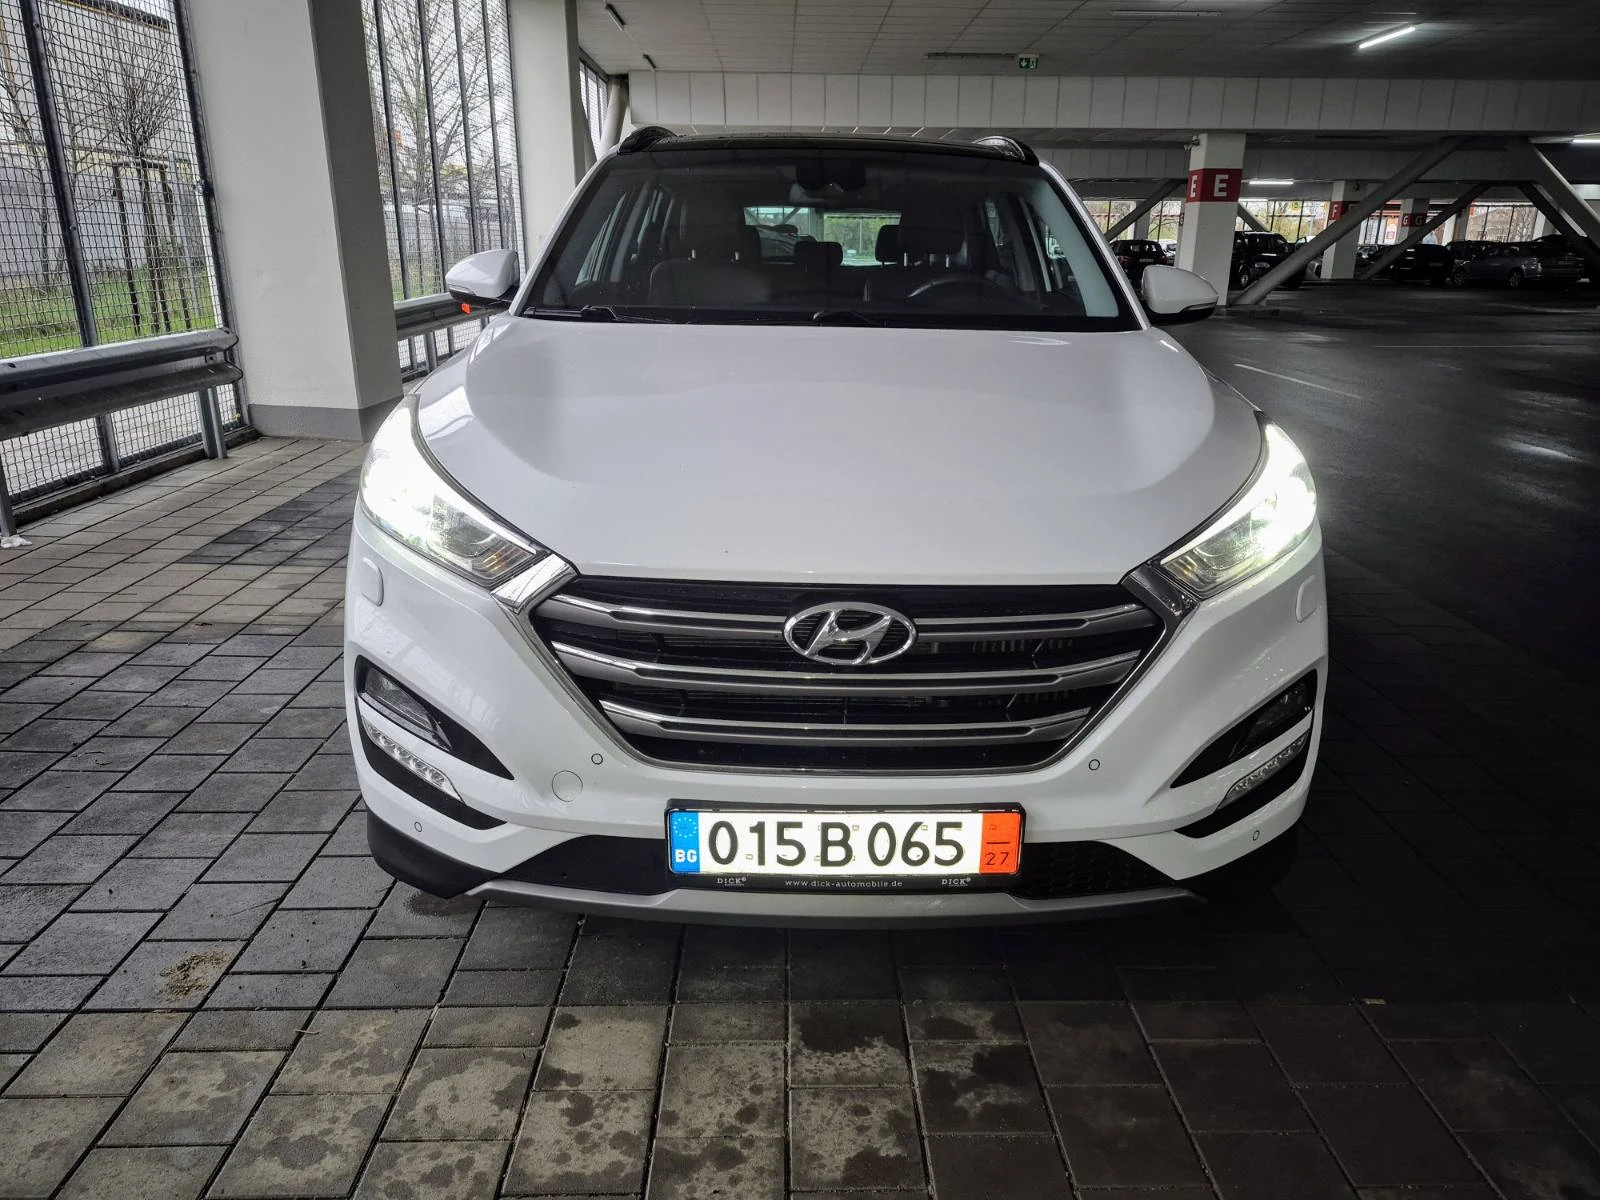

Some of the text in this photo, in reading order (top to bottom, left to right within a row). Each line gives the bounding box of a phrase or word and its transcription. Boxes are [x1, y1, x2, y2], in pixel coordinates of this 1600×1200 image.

[1190, 174, 1199, 198] E
[1213, 174, 1229, 197] E
[674, 849, 698, 863] BG
[984, 852, 1010, 866] 27
[784, 880, 904, 888] www.dick-automobile.de
